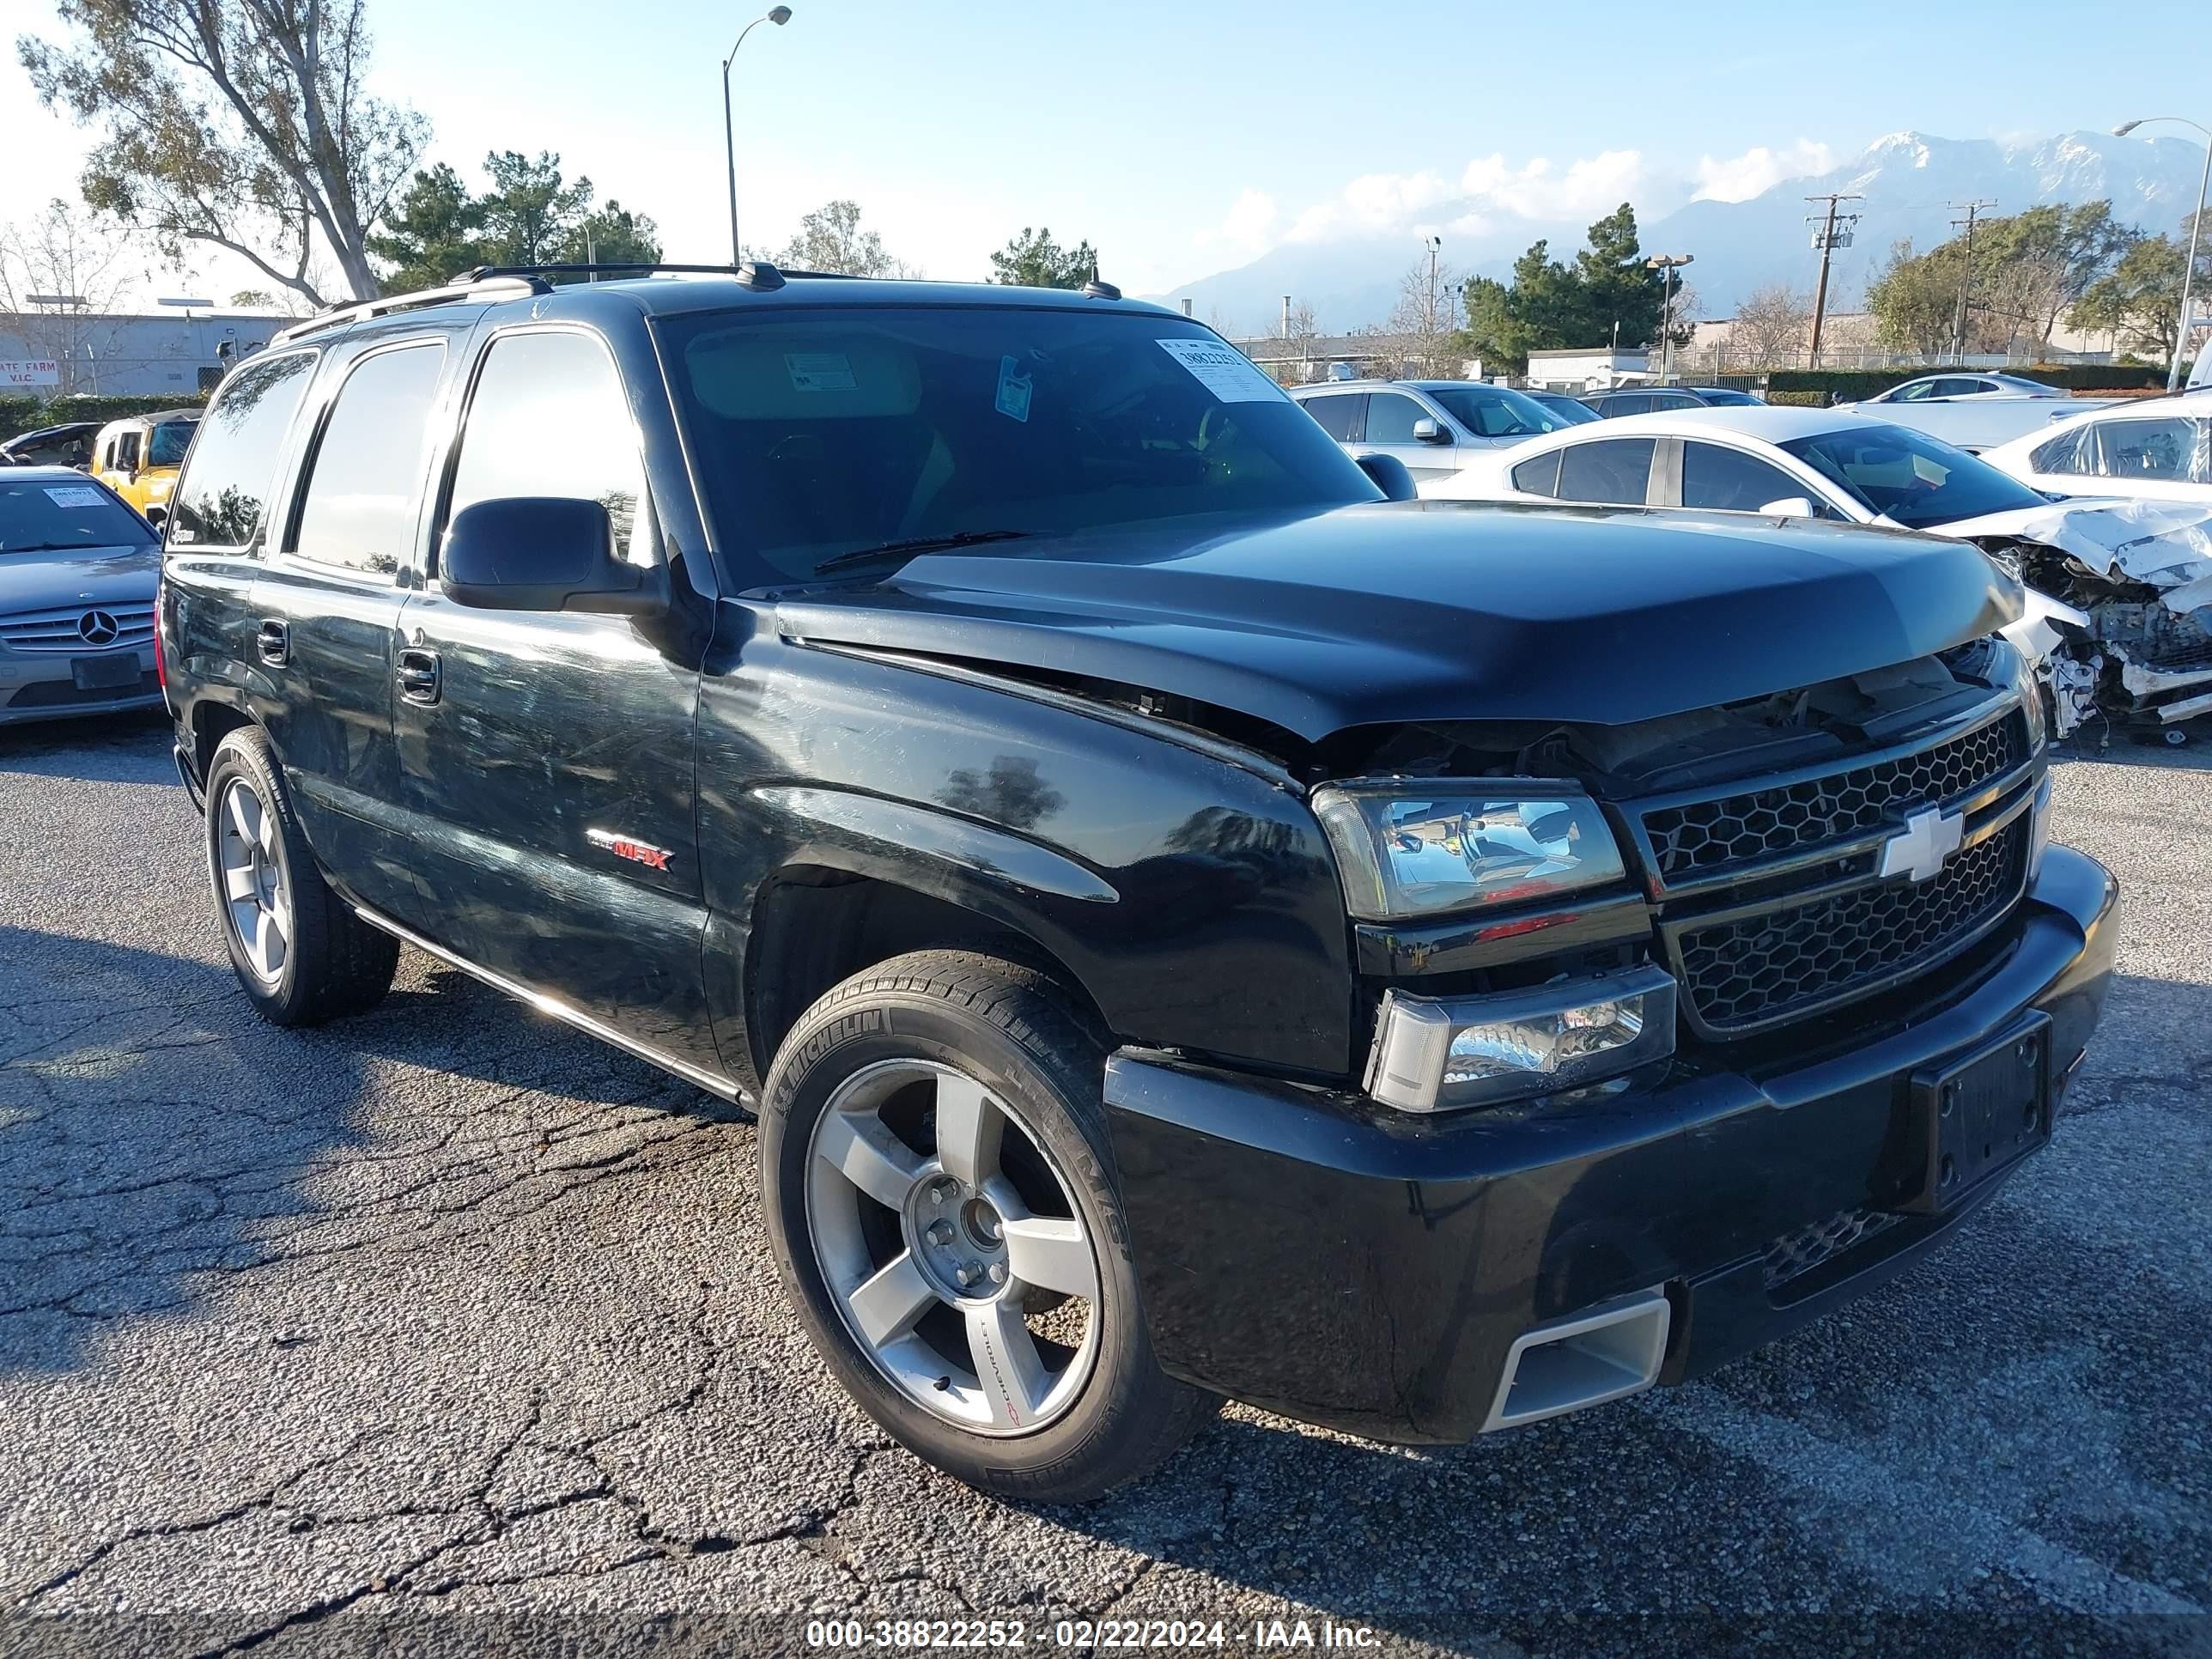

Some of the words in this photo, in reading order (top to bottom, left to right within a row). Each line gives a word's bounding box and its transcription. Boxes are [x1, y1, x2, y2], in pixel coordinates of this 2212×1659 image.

[1180, 352, 1242, 366] 38822252
[26, 362, 55, 372] FARM
[9, 374, 35, 382] V.I.C.
[786, 1009, 881, 1086] MICHELIN
[981, 1319, 1011, 1402] CHEVROLET
